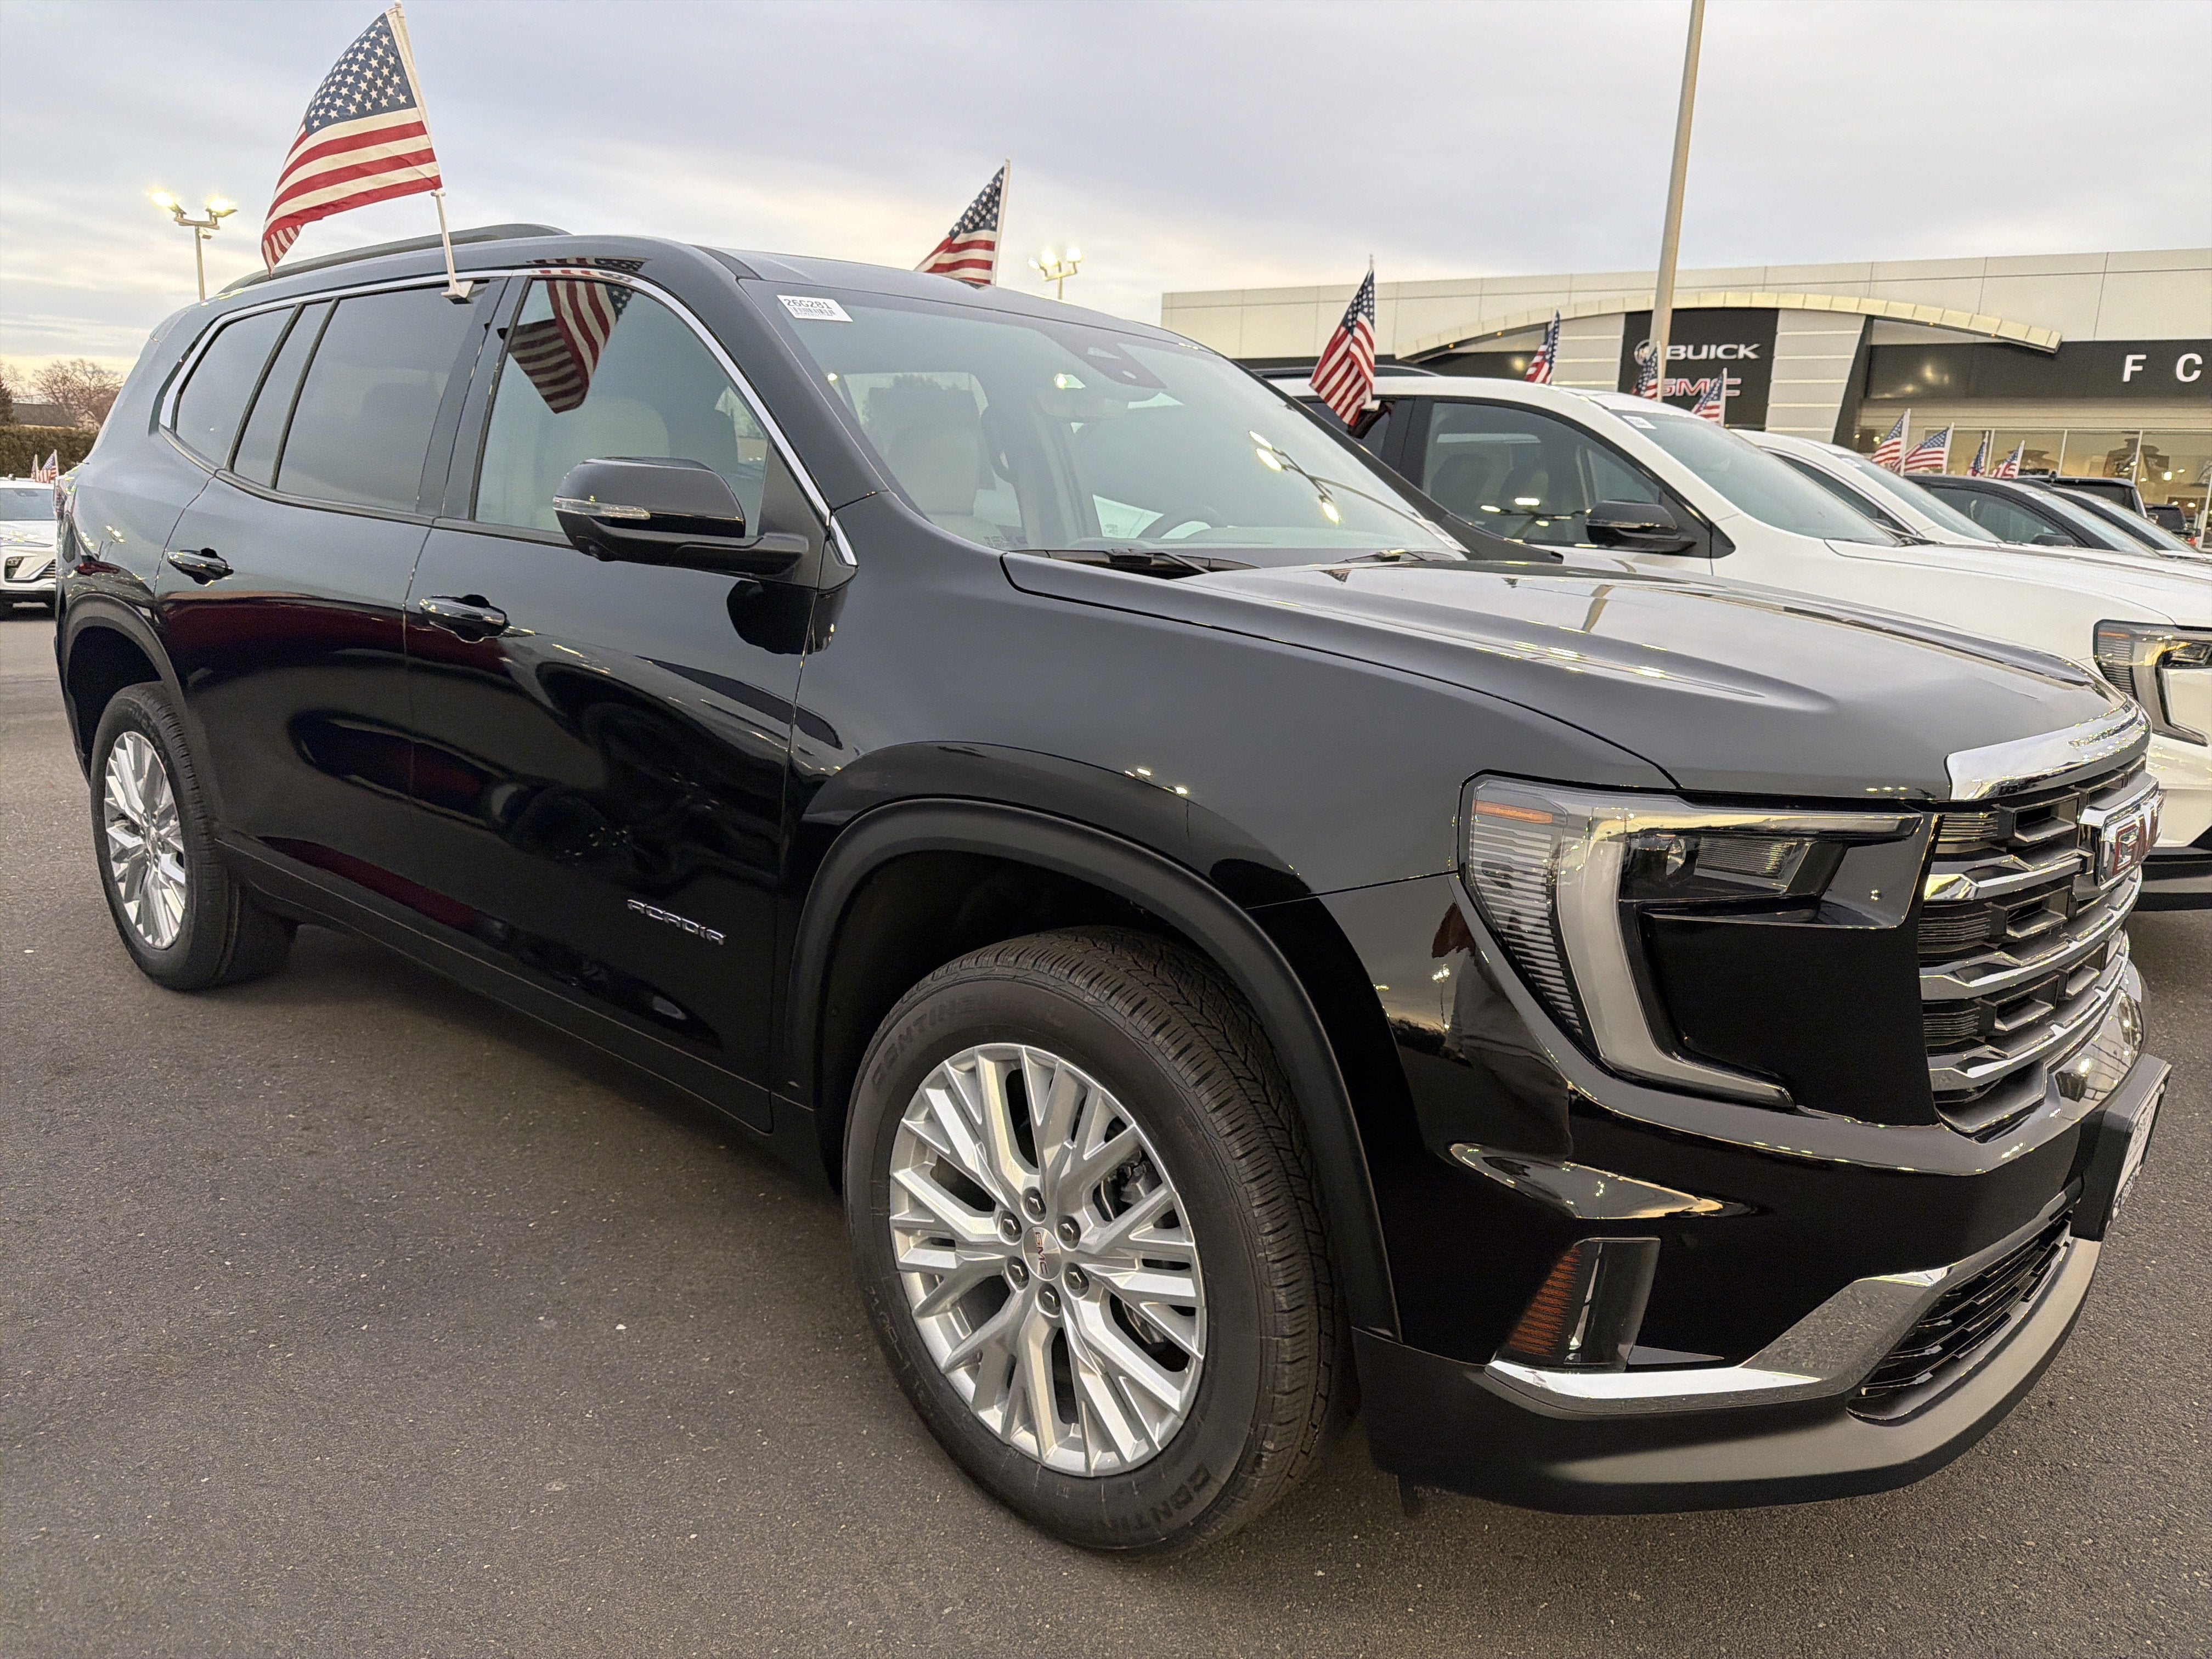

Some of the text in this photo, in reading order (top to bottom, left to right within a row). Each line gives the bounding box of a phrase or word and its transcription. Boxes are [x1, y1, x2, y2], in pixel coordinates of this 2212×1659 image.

[783, 298, 833, 309] 26G281
[1666, 343, 1760, 360] BUICK
[1035, 1231, 1048, 1275] GMC
